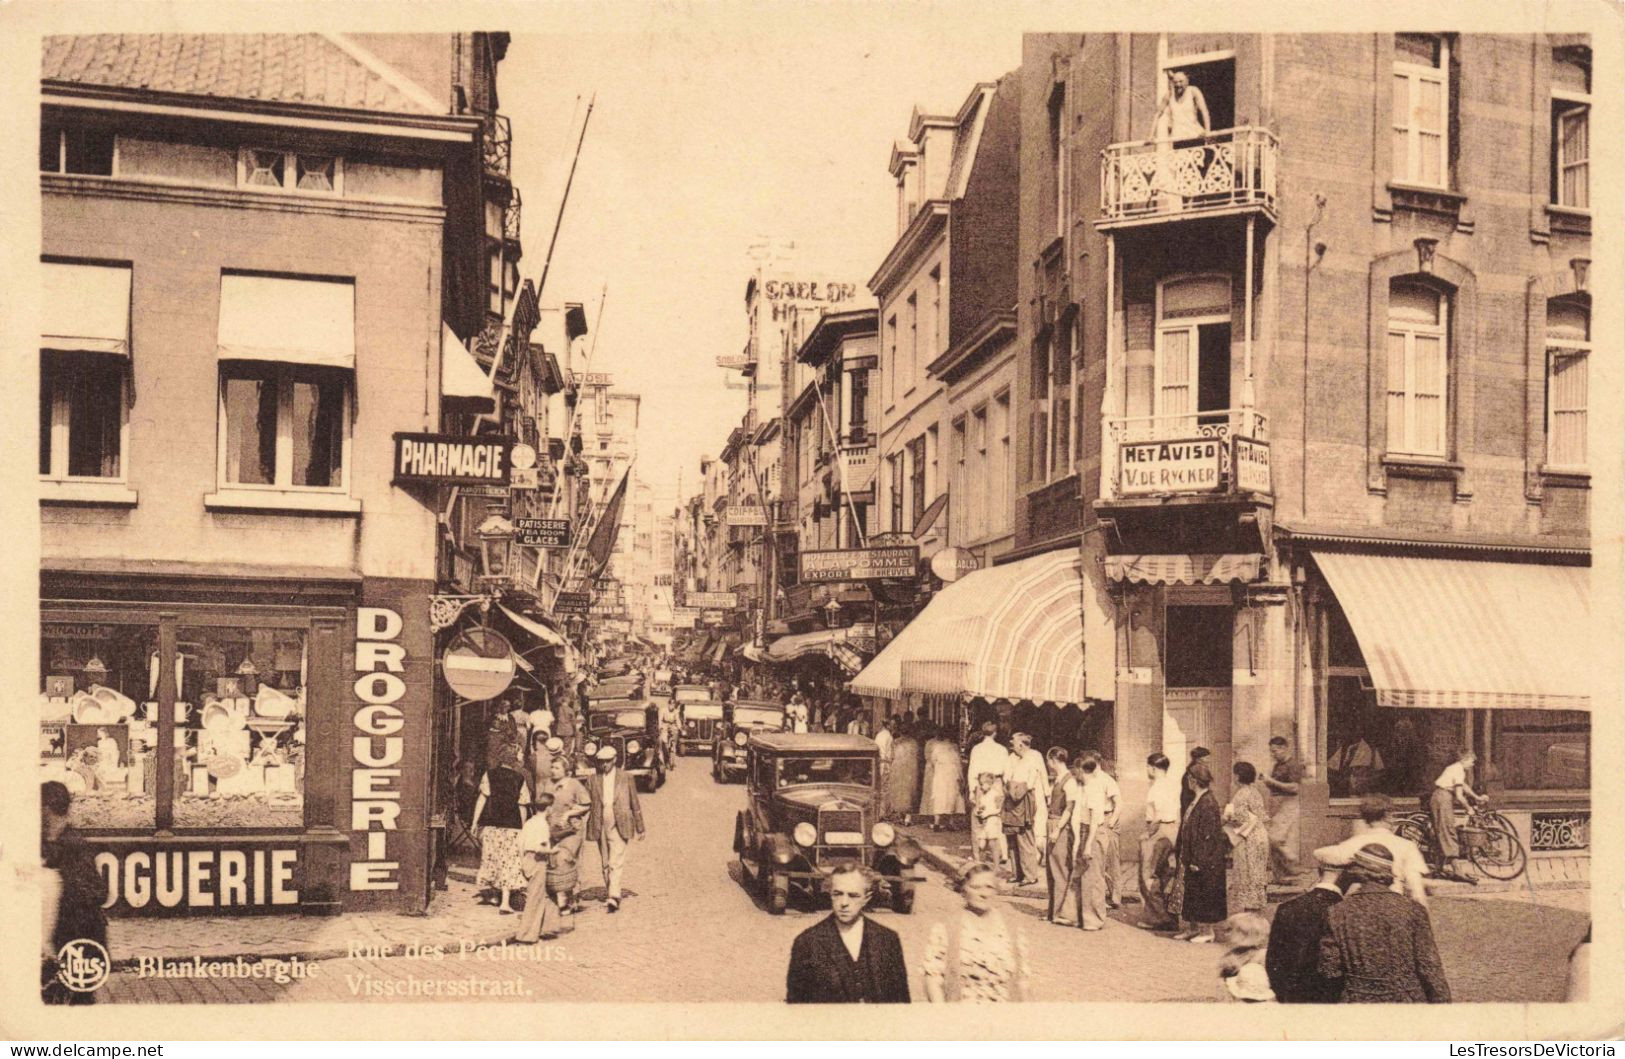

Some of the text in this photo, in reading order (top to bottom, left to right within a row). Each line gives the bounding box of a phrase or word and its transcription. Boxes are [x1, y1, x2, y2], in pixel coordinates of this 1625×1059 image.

[401, 440, 503, 479] PHARMACIE
[1125, 444, 1216, 463] HET AVISO
[1160, 467, 1216, 486] RYCKER
[519, 519, 567, 529] PATISSERIE
[523, 536, 559, 545] GLACES
[846, 558, 912, 569] POMME
[803, 570, 849, 579] EXPORT
[349, 607, 406, 891] DROGUERIE
[94, 849, 298, 909] OGUERIE
